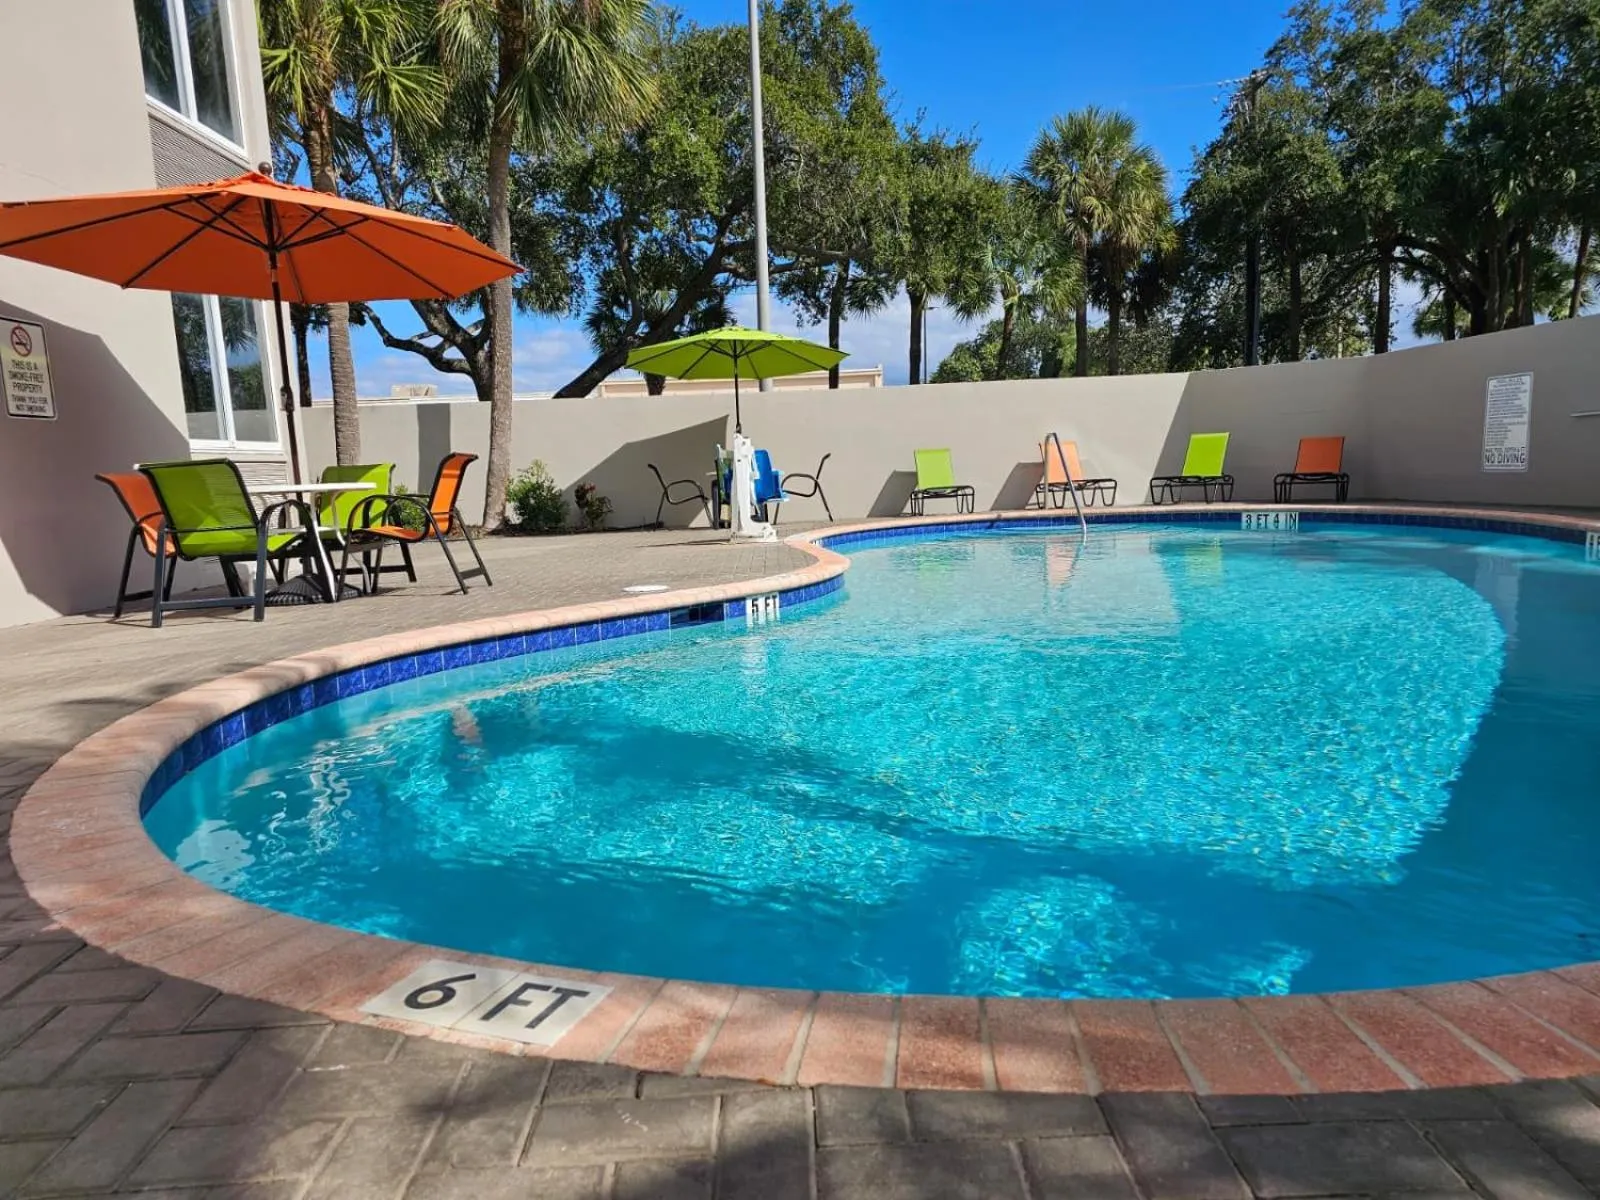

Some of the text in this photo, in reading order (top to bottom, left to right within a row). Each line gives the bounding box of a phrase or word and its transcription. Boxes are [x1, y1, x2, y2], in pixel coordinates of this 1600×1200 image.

[11, 359, 24, 369] THIS
[12, 382, 43, 393] PROPERTY
[1485, 453, 1525, 464] NO DIVING
[404, 973, 590, 1029] 6 FT
